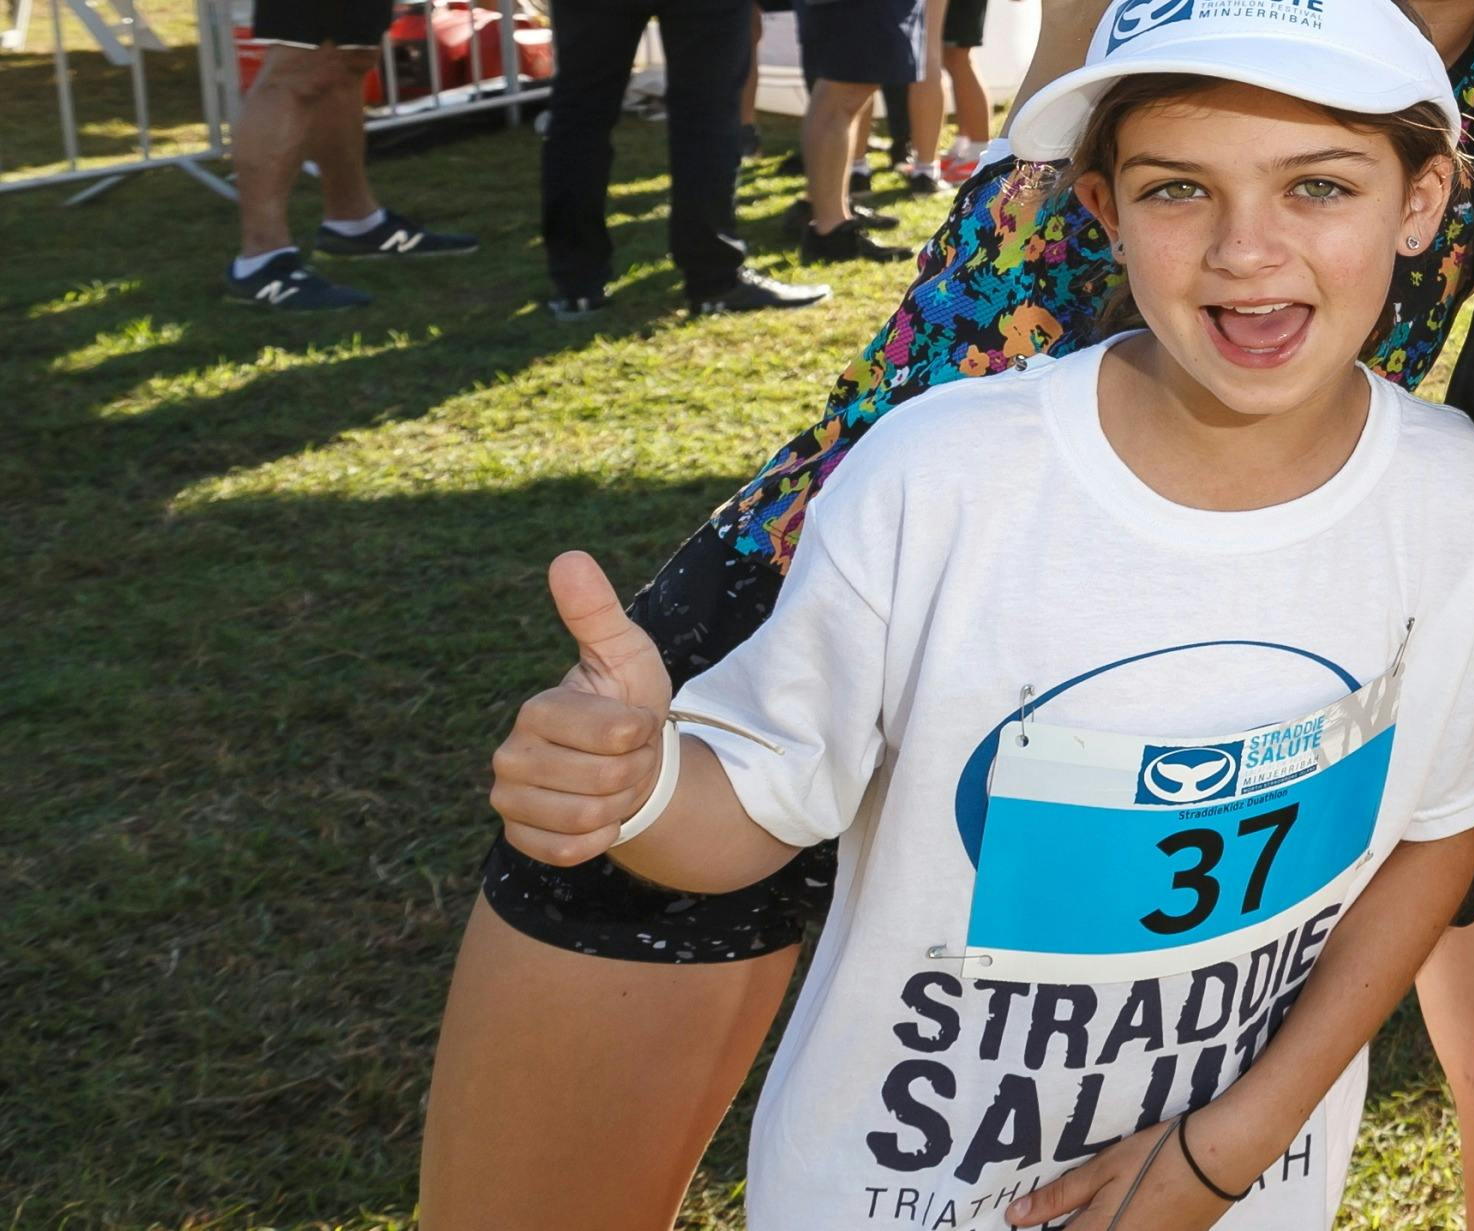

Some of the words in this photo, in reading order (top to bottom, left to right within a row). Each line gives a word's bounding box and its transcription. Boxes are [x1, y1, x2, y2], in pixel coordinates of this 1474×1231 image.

[1199, 7, 1322, 30] MINJERRIBAH
[1201, 0, 1264, 9] TRIATHLON
[1270, 2, 1322, 20] FESTIVAL
[1250, 715, 1325, 750] STRADDIE
[1246, 730, 1322, 769] SALUTE
[1243, 754, 1319, 786] MINJERRIBAH
[1178, 801, 1244, 820] StraddieKidz
[1247, 789, 1288, 807] Duathlon
[1139, 802, 1300, 936] 37
[893, 903, 1342, 1069] STRADDIE
